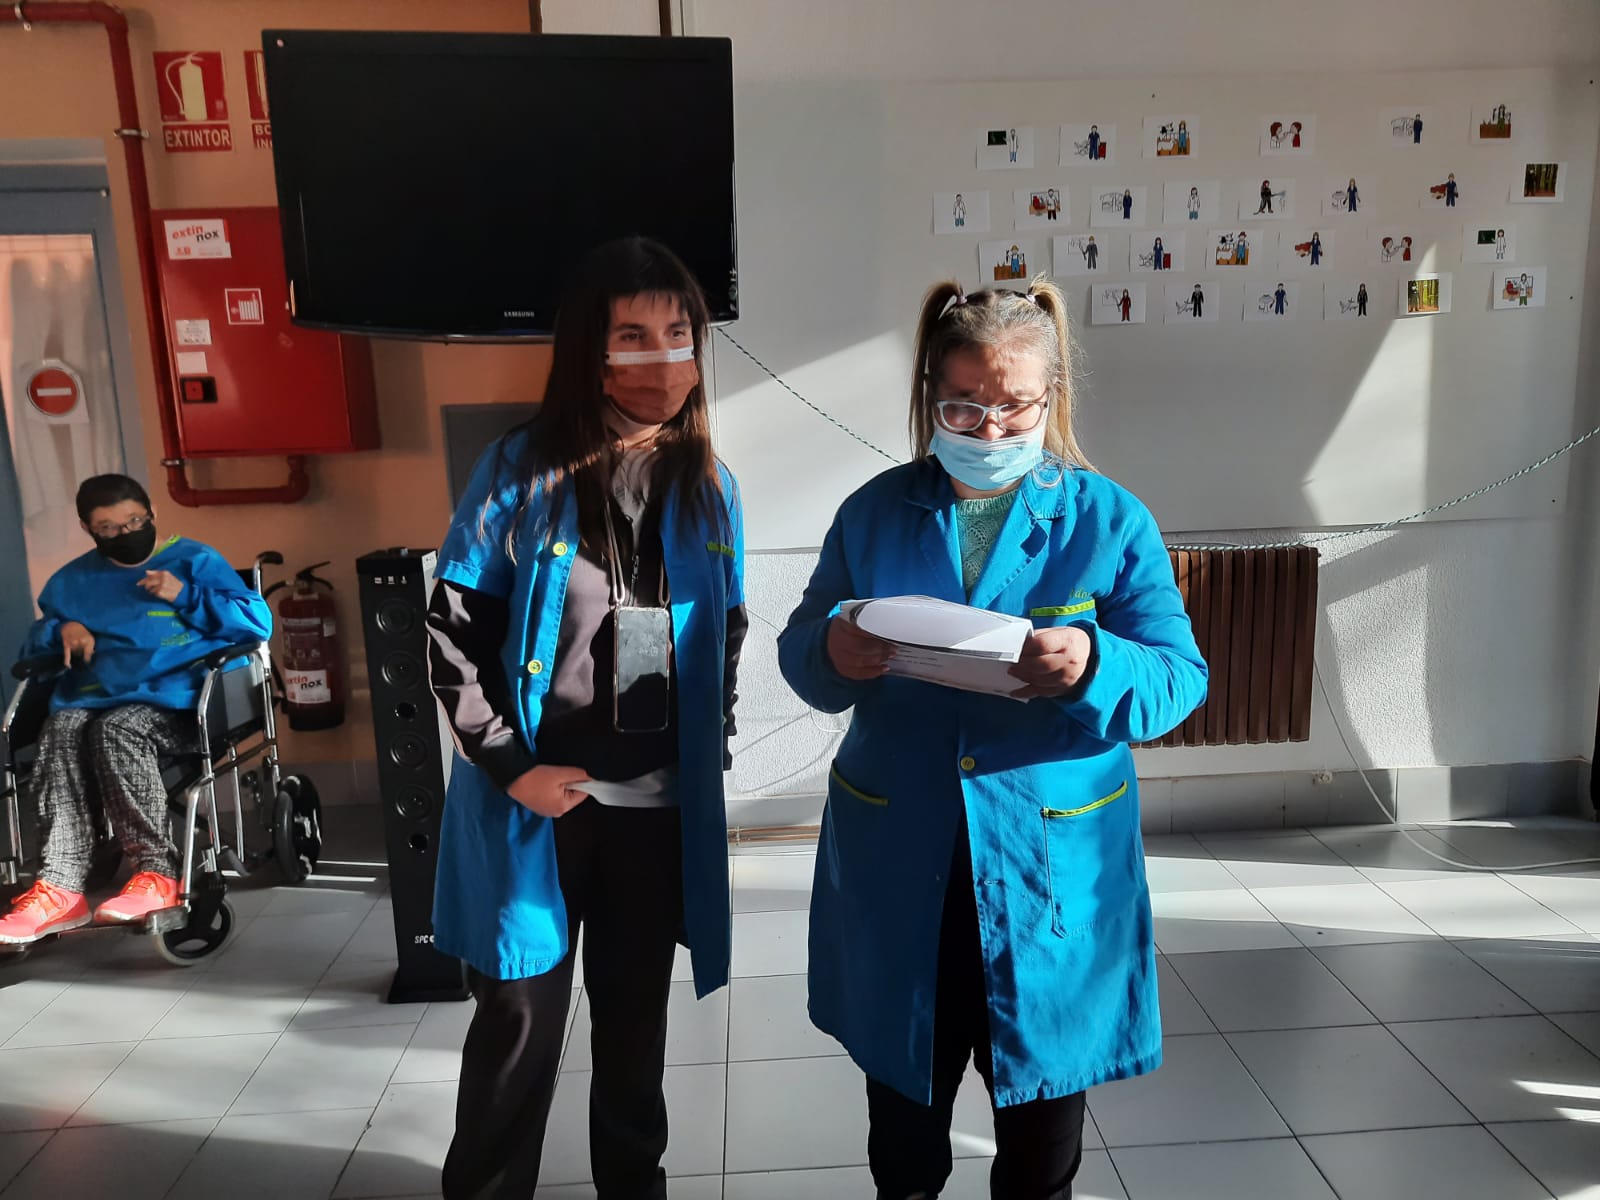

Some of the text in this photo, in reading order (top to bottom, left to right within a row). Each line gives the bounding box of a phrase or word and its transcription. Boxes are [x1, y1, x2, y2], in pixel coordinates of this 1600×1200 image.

[165, 128, 231, 148] EXTINTOR
[172, 225, 204, 240] extin
[196, 230, 219, 243] nox
[300, 679, 322, 690] nox
